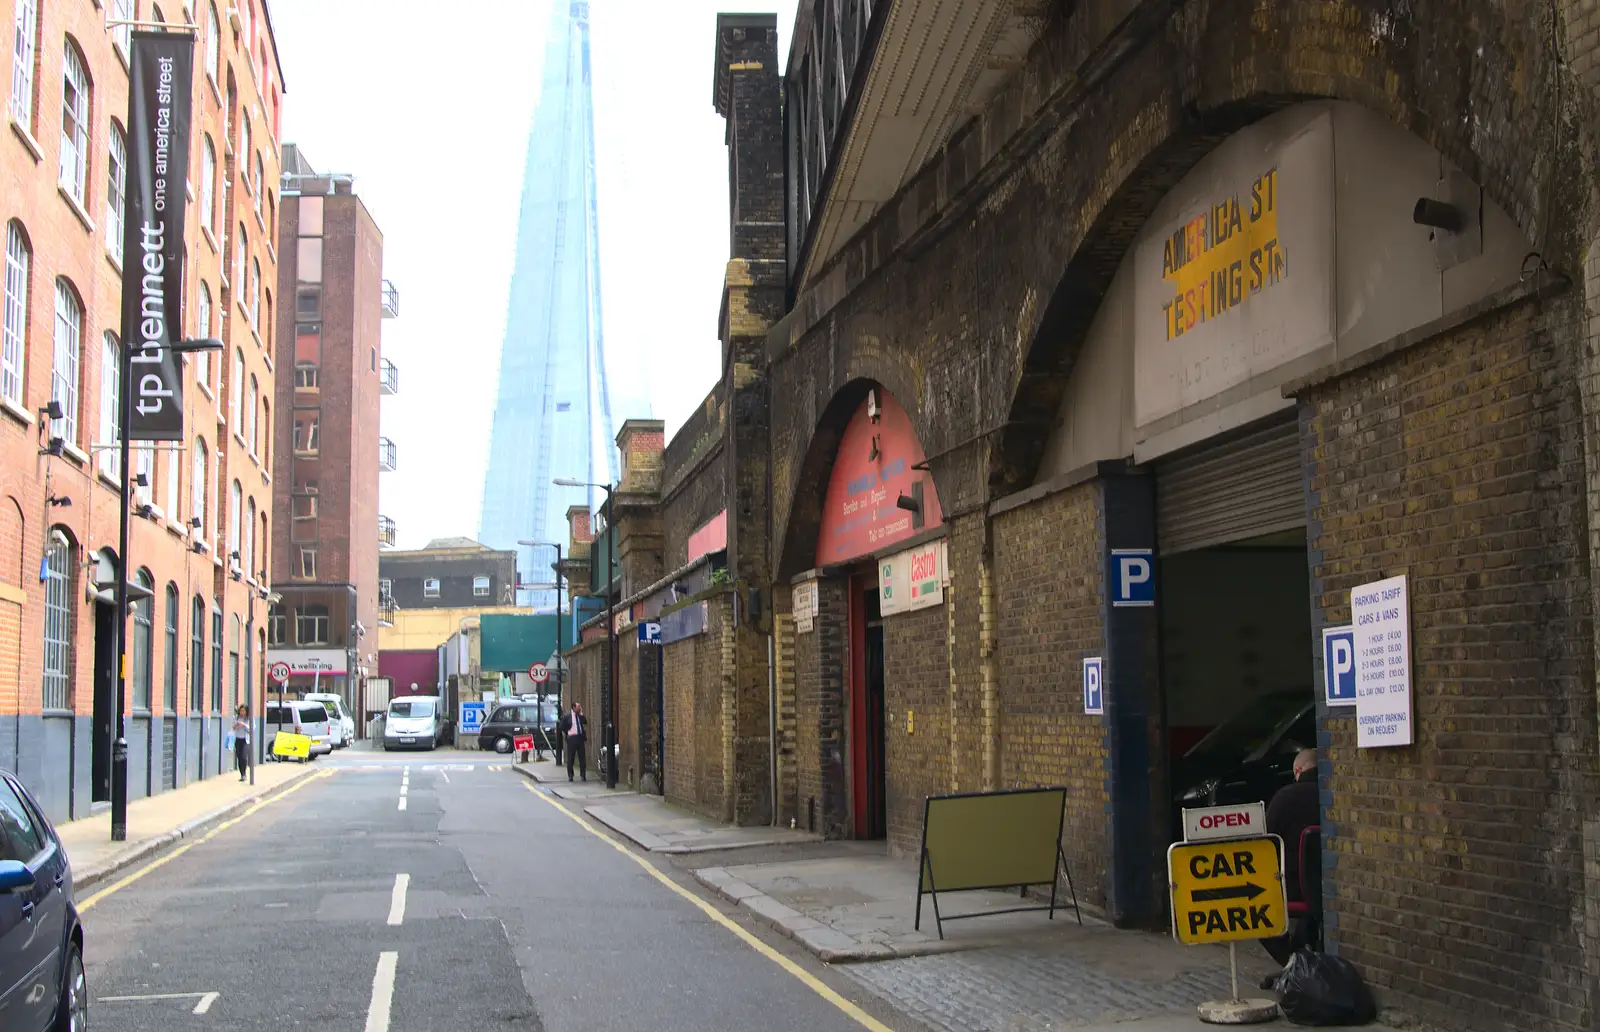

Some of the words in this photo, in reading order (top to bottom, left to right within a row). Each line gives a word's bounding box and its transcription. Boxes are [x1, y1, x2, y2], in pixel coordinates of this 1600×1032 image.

[157, 56, 173, 104] street
[154, 108, 170, 175] america
[155, 178, 165, 212] one
[1162, 191, 1242, 280] AMERICA
[1250, 163, 1277, 223] ST
[131, 221, 164, 363] bennett
[1161, 259, 1242, 342] TESTING
[136, 373, 173, 417] tp
[911, 545, 937, 582] Castrol
[1119, 557, 1151, 600] P
[1355, 592, 1380, 608] PARKING
[1382, 587, 1401, 601] TARIFF
[1358, 612, 1374, 626] CARS
[1376, 611, 1380, 623] &
[1382, 607, 1399, 621] VANS
[1370, 645, 1385, 656] HOURS
[1371, 633, 1384, 644] HOUR
[273, 667, 288, 677] 30
[531, 667, 547, 677] 30
[1332, 638, 1352, 696] P
[1370, 658, 1385, 668] HOURS
[1370, 670, 1385, 681] HOURS
[1088, 666, 1099, 708] P
[1359, 714, 1384, 725] OVERNIGHT
[1385, 711, 1407, 722] PARKING
[1367, 727, 1375, 736] ON
[1375, 724, 1398, 736] REQUEST
[1200, 811, 1250, 829] OPEN
[1189, 851, 1257, 880] CAR
[1187, 903, 1275, 936] PARK
